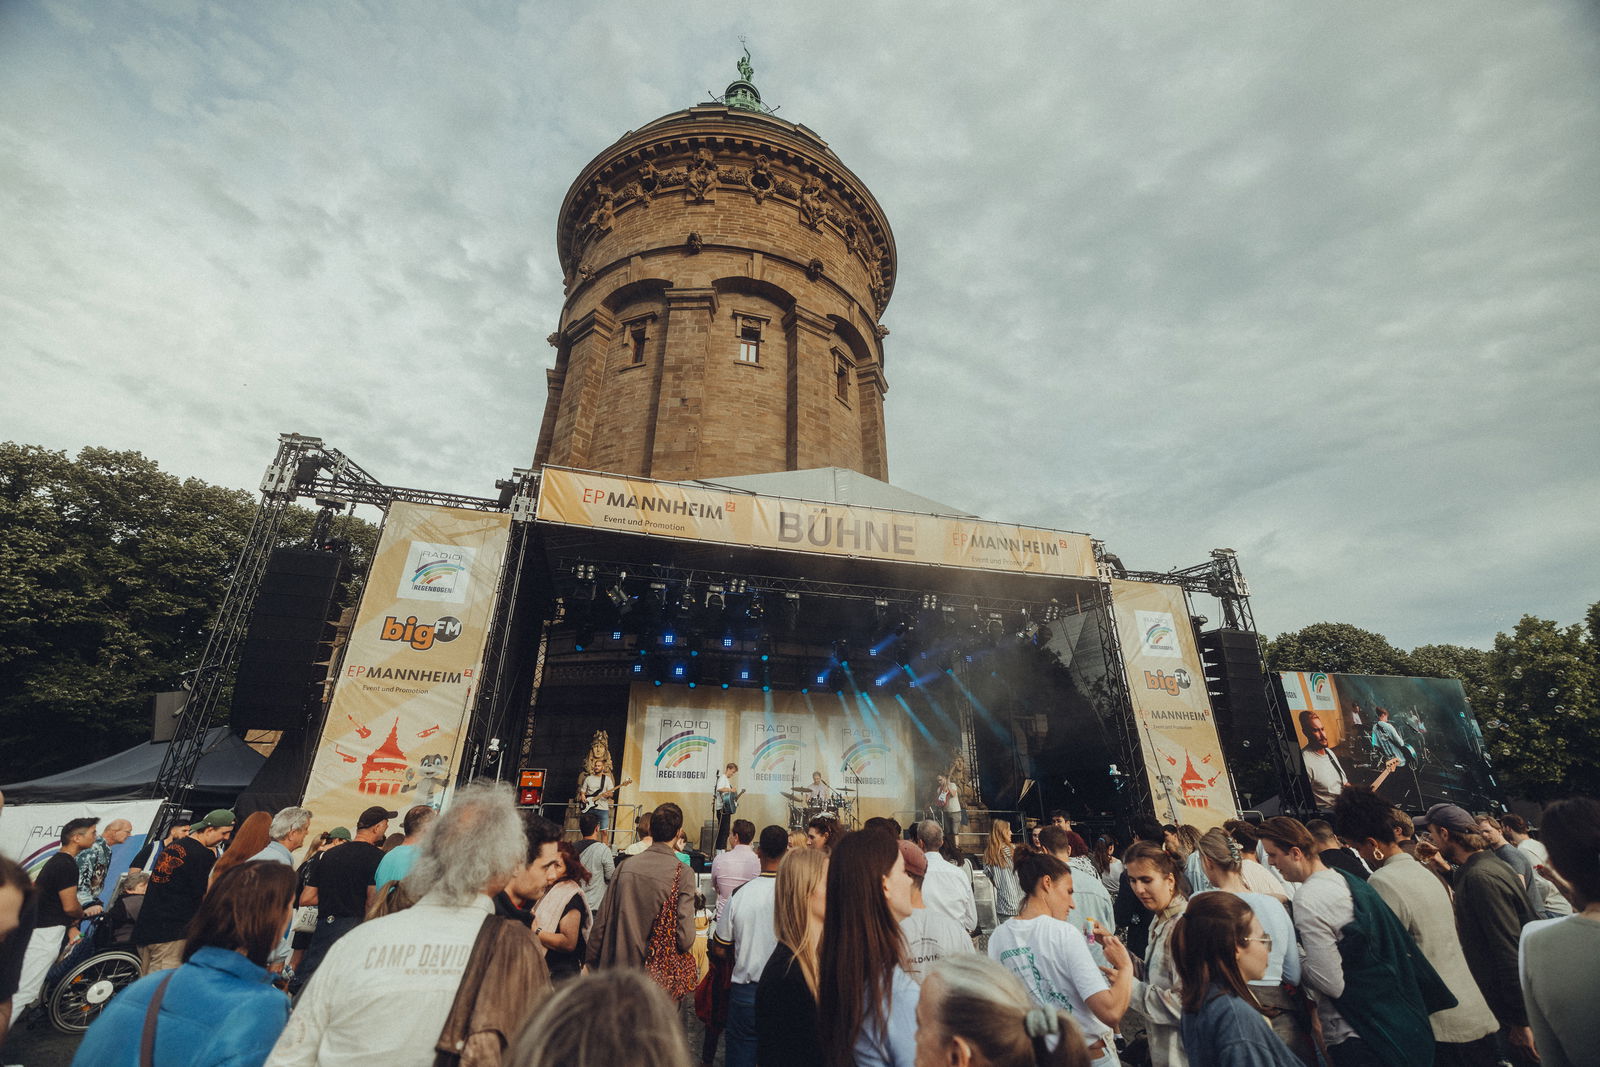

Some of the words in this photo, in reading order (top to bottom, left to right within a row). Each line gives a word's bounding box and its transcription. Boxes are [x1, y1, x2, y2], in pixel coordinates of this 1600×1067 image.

[603, 514, 626, 525] Event
[628, 518, 643, 528] und
[644, 520, 685, 532] Promotion
[777, 507, 916, 556] BÜHNE
[422, 550, 461, 561] RADIO
[413, 584, 453, 594] REGENBOGEN
[362, 684, 381, 692] Event
[395, 687, 429, 695] Promotion
[662, 719, 709, 730] RADIO
[756, 723, 800, 734] RADIO
[658, 770, 706, 779] REGENBOGEN
[32, 825, 63, 838] RAD
[364, 943, 416, 969] CAMP
[418, 943, 470, 967] DAVID
